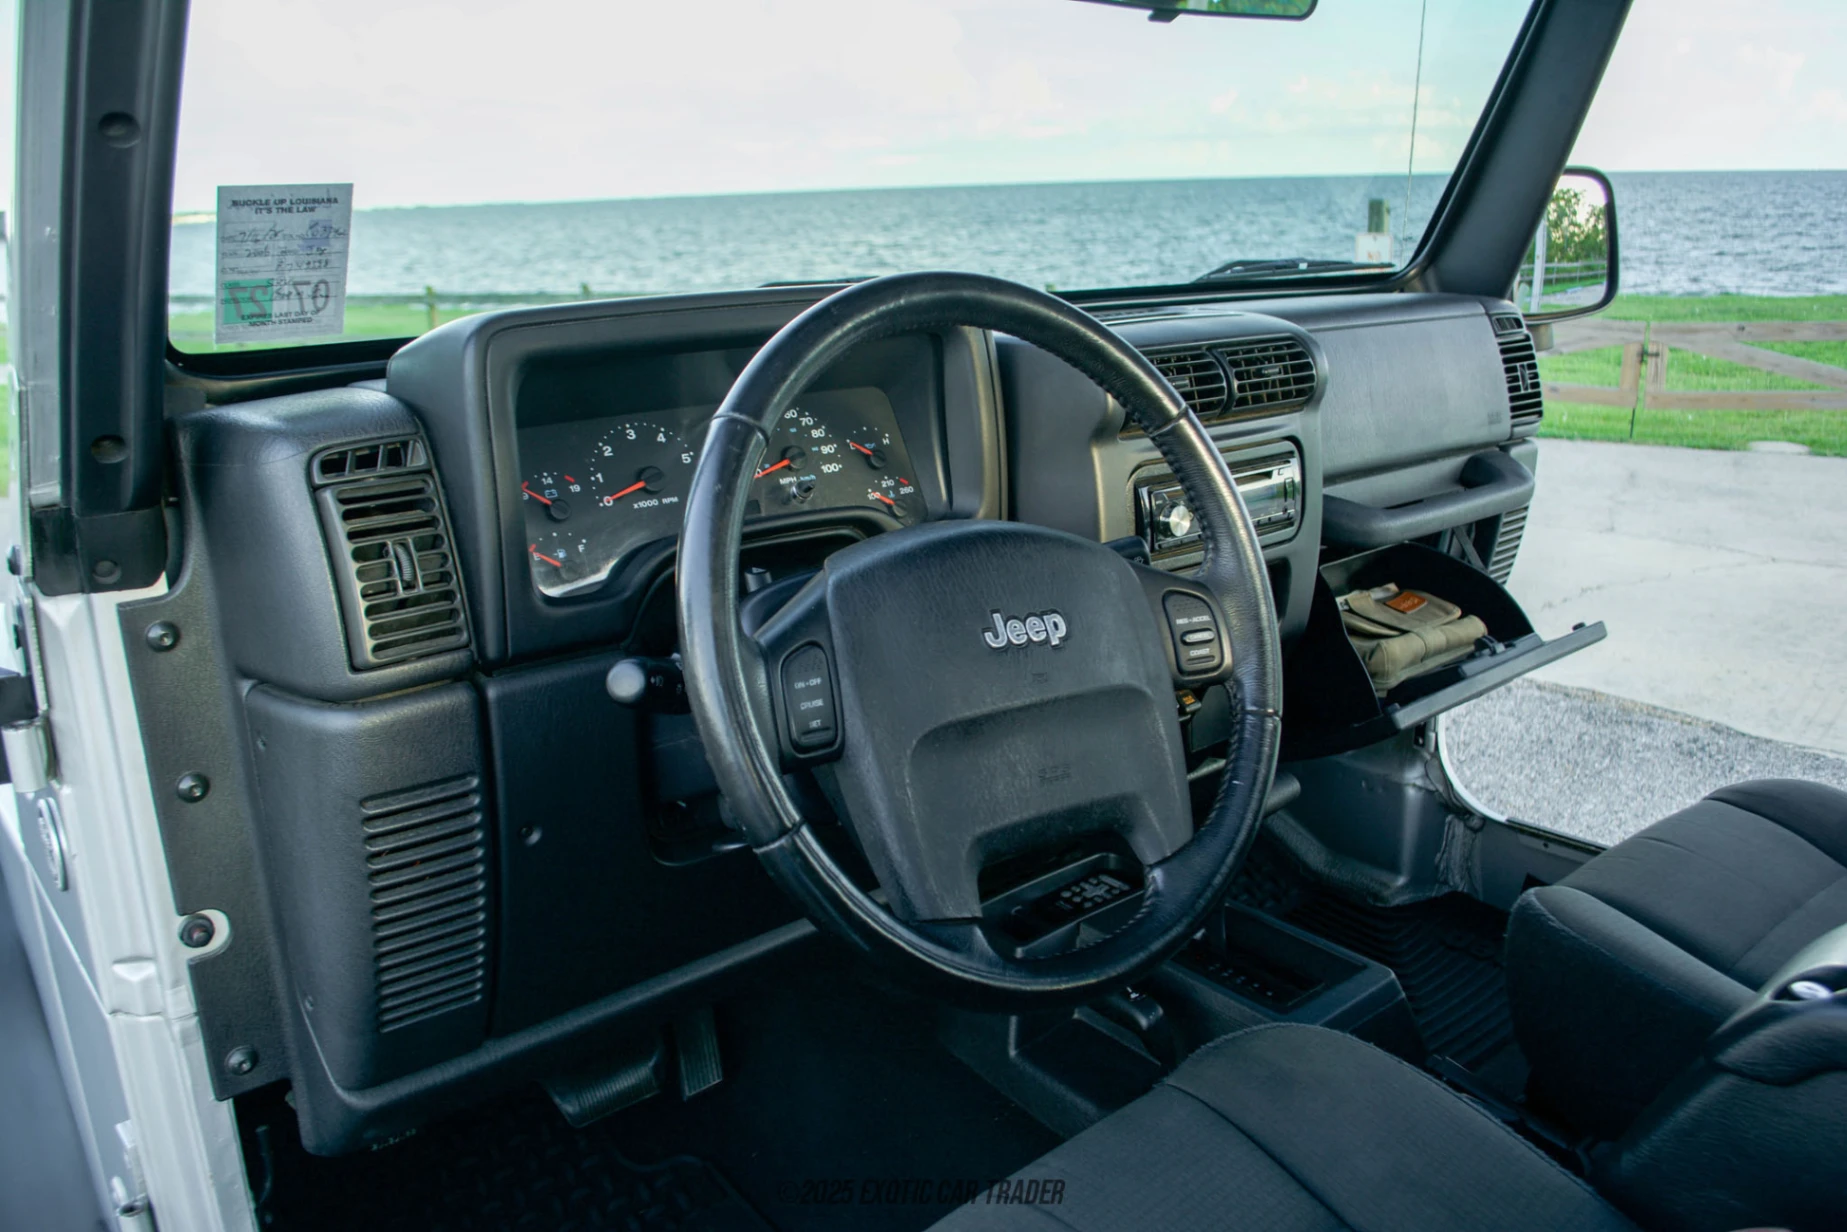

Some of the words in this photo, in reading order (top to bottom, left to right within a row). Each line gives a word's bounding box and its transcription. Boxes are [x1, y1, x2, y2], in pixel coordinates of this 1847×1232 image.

[231, 199, 269, 207] BUCKLE
[273, 198, 287, 206] UP
[289, 197, 338, 205] LOUISIANA
[275, 206, 295, 214] THE
[296, 205, 316, 213] LAW
[274, 311, 293, 319] LAST
[294, 310, 311, 318] DAY
[248, 319, 277, 327] MONTH
[277, 317, 312, 325] STAMPED
[799, 417, 814, 427] 70
[625, 428, 637, 440] 3
[656, 432, 667, 443] 4
[811, 428, 826, 438] 80
[882, 437, 890, 446] H
[602, 445, 614, 457] 2
[820, 444, 835, 454] 90
[681, 452, 692, 464] 5
[820, 463, 840, 473] 100
[541, 477, 553, 485] 14
[596, 472, 604, 483] 1
[779, 476, 797, 485] MPH
[881, 478, 895, 488] 210
[568, 484, 581, 493] 19
[899, 486, 914, 495] 260
[603, 496, 614, 507] 0
[633, 499, 659, 510] x1000
[662, 496, 679, 504] RPM
[983, 611, 1067, 648] Jeep
[800, 698, 824, 710] CRUISE
[809, 719, 822, 729] SET
